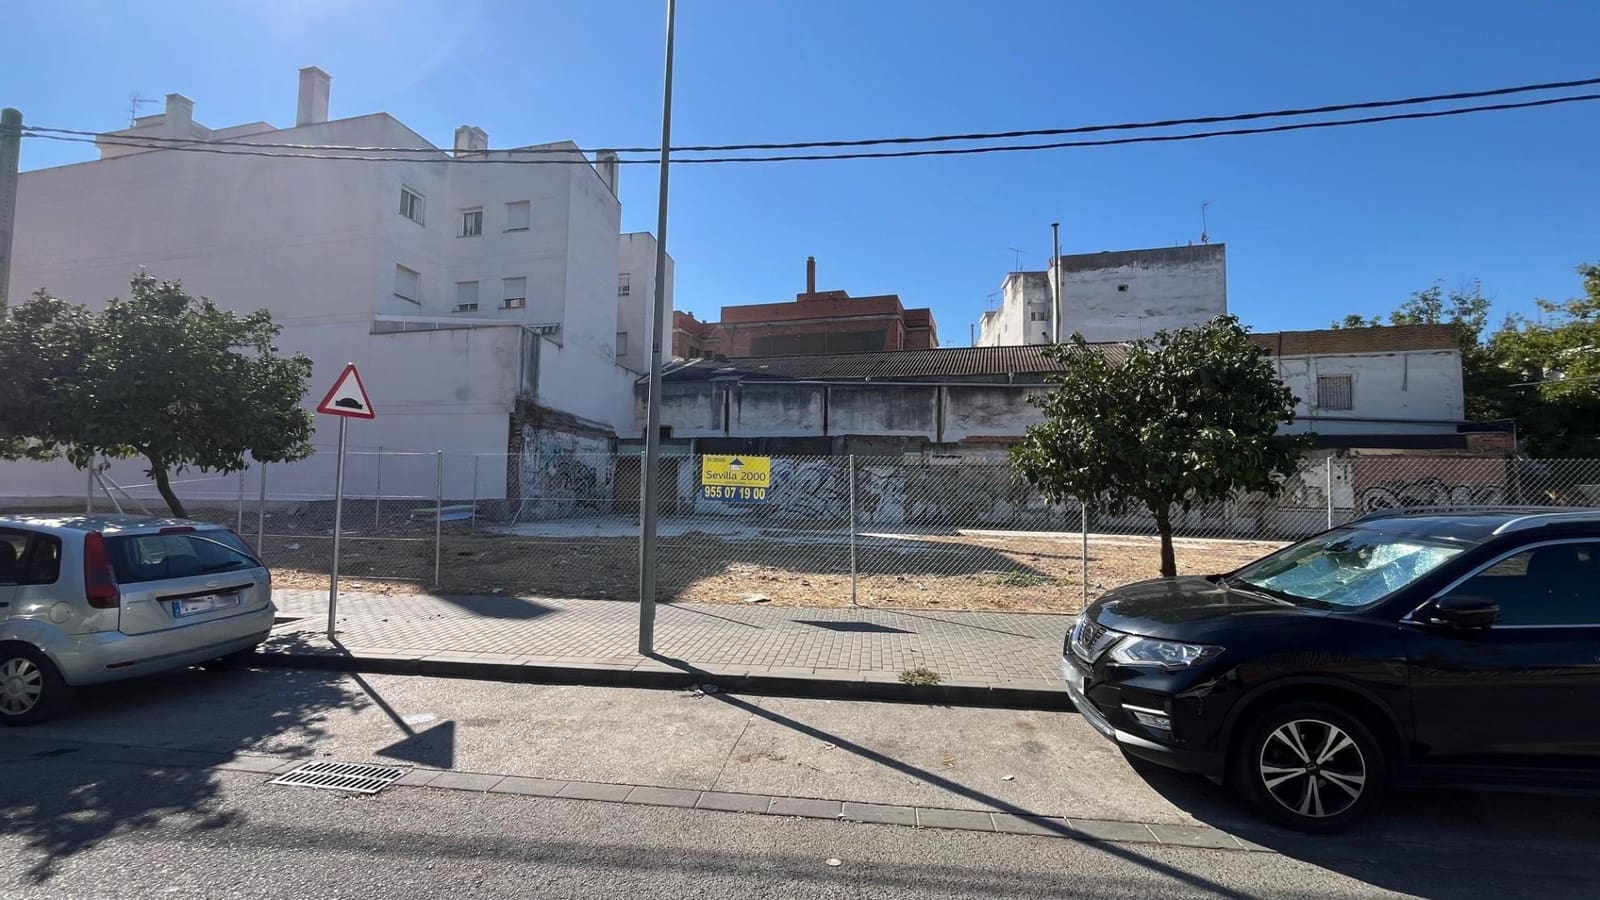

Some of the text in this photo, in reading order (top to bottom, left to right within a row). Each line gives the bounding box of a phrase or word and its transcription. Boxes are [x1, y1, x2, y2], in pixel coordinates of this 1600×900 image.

[706, 470, 766, 481] Sevilla 2000
[705, 486, 766, 500] 955 07 19 00
